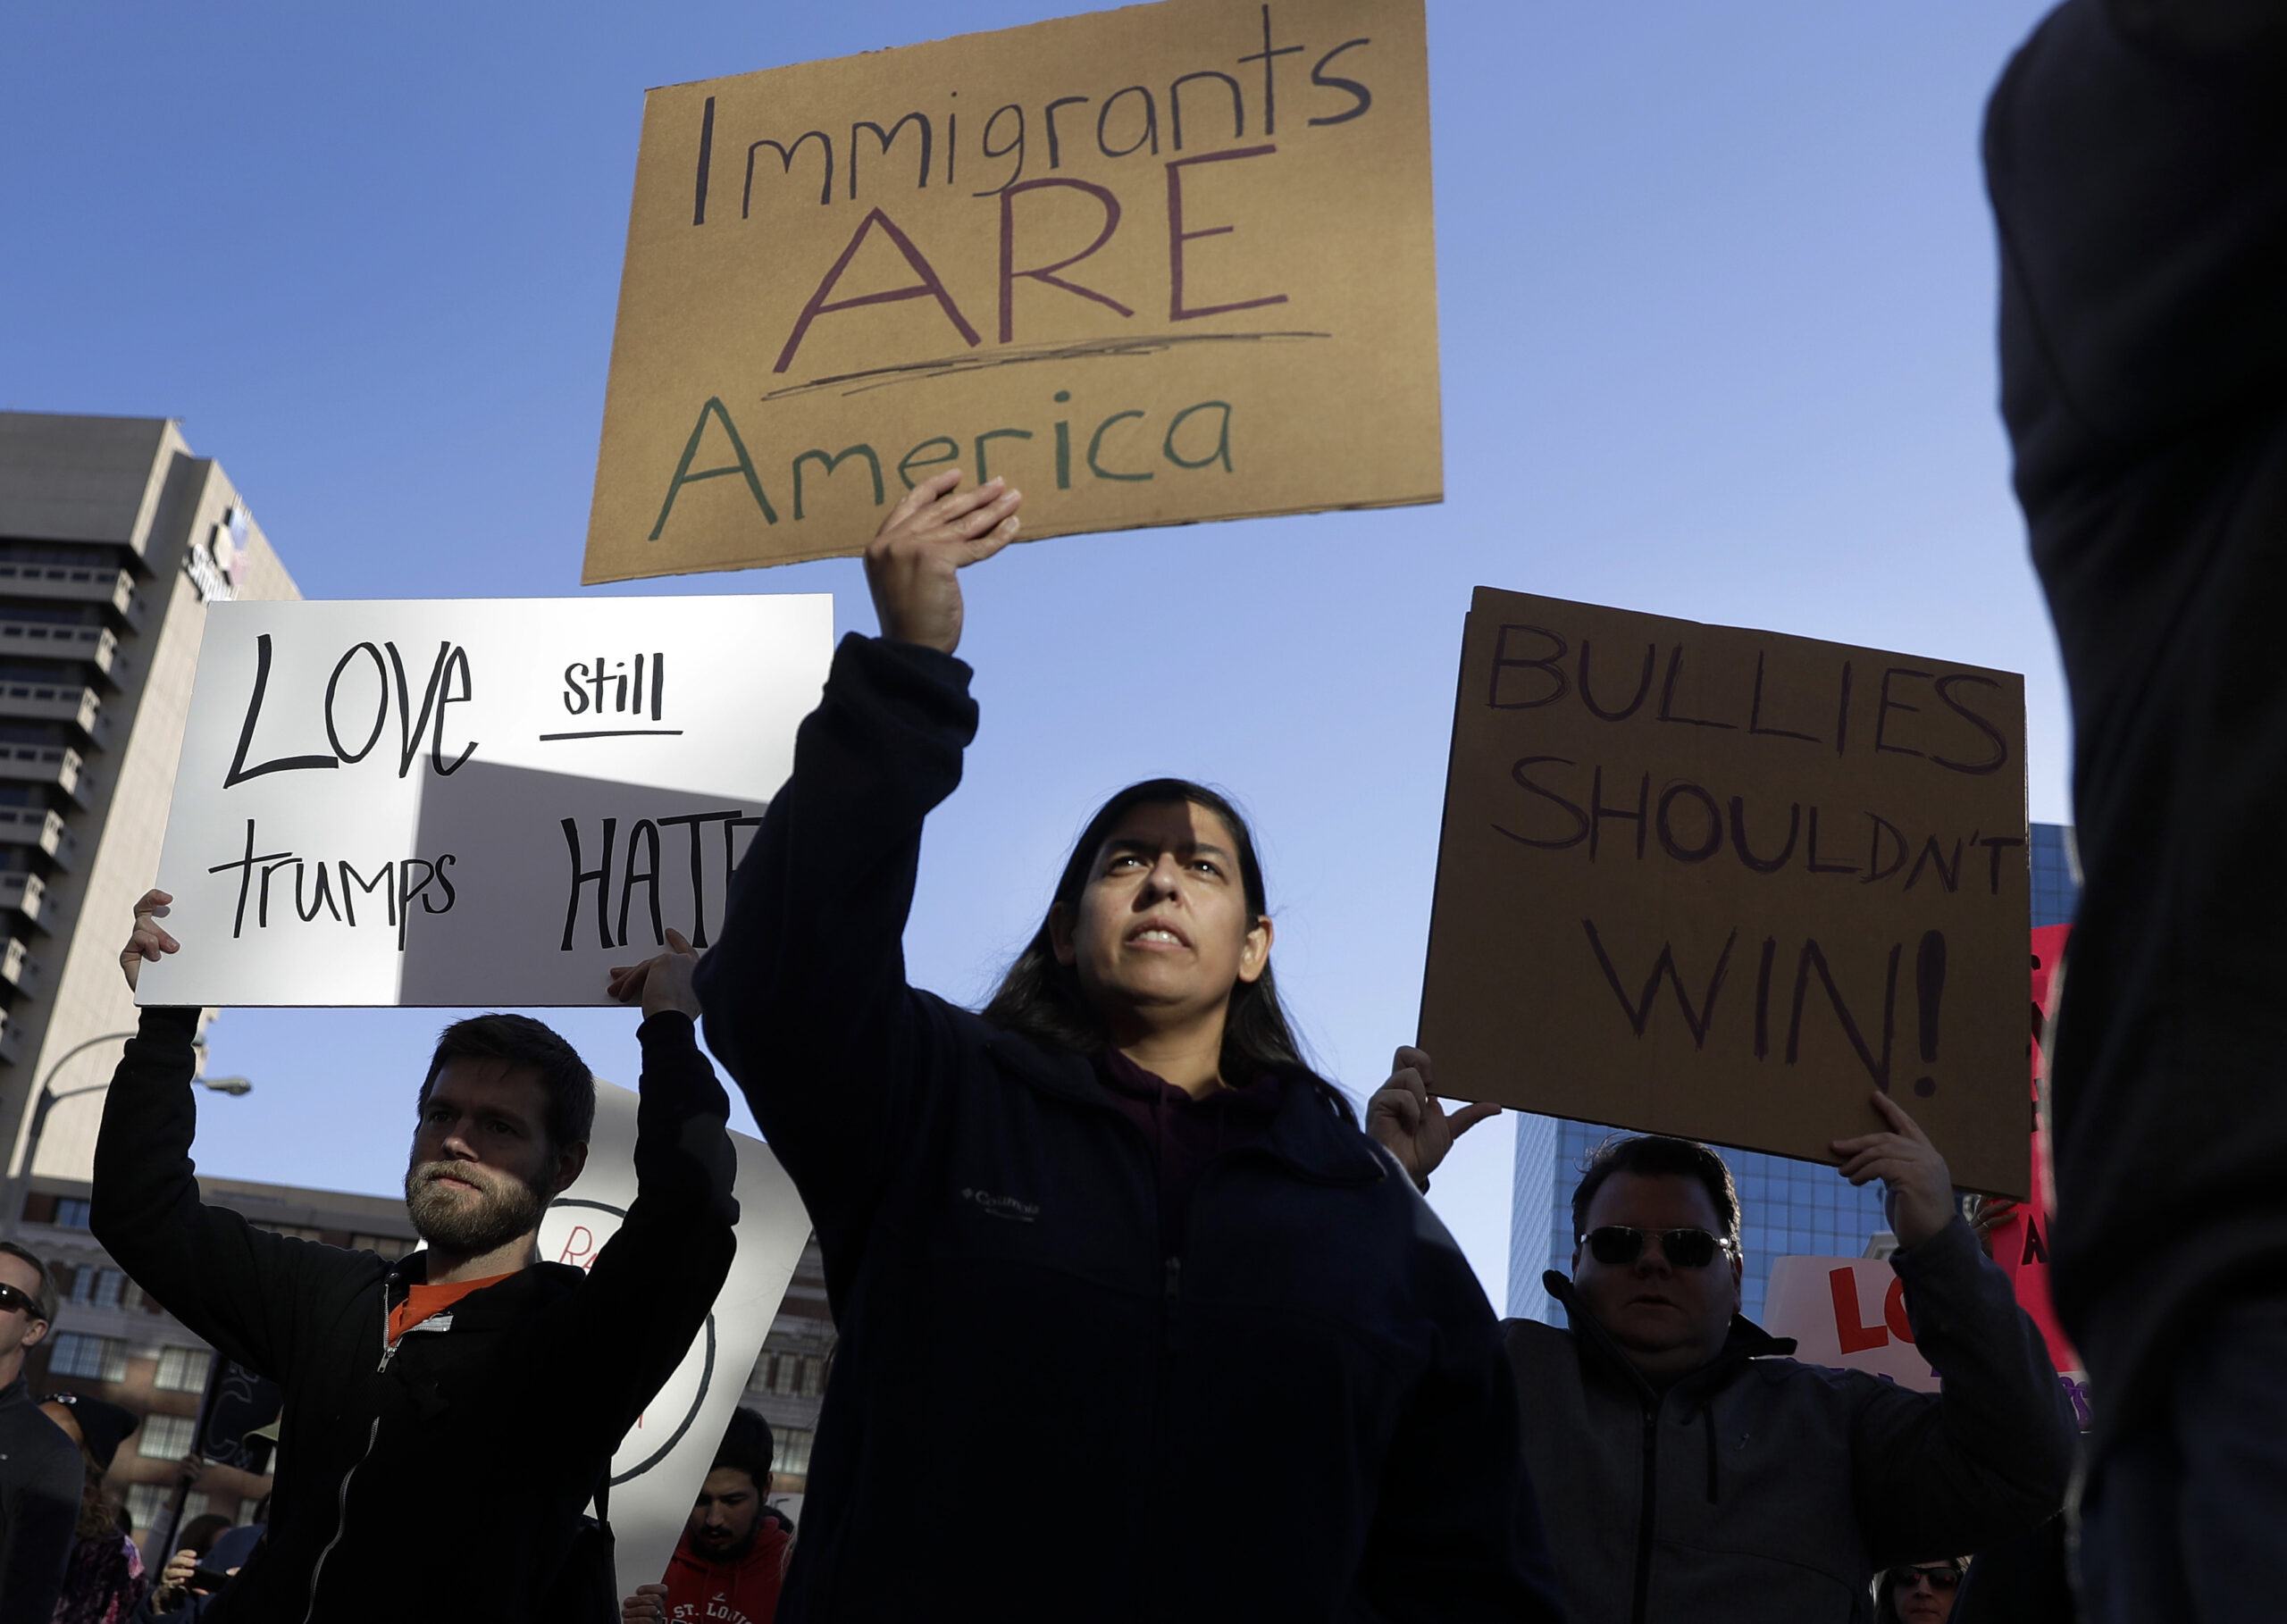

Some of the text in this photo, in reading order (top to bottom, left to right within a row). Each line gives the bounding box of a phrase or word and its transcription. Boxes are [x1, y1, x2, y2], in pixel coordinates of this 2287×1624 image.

[692, 4, 1372, 226] Immigrants
[772, 143, 1289, 374] ARE
[648, 389, 1233, 542] America
[562, 651, 666, 722] still
[1486, 623, 2009, 776] BULLIES
[1490, 755, 2026, 895] SHOULDN'T
[1579, 917, 1948, 1100] WIN!
